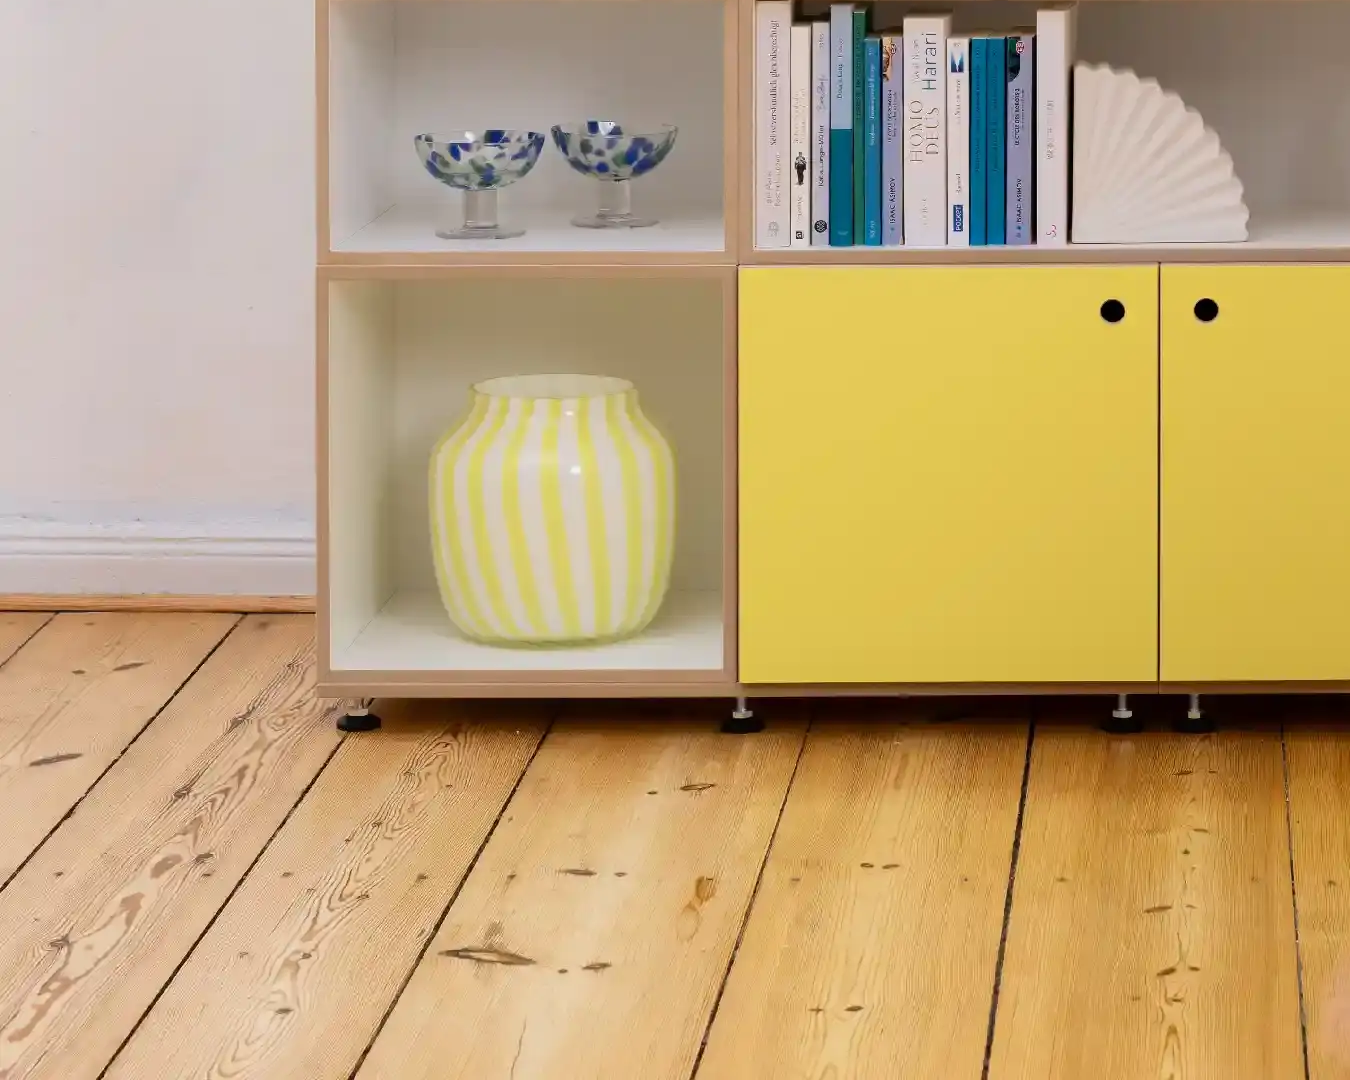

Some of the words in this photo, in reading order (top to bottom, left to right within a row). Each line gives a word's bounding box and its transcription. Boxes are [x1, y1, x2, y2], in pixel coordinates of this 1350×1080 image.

[922, 32, 938, 91] Harari
[908, 100, 924, 164] HOMO
[926, 107, 940, 156] DEUS
